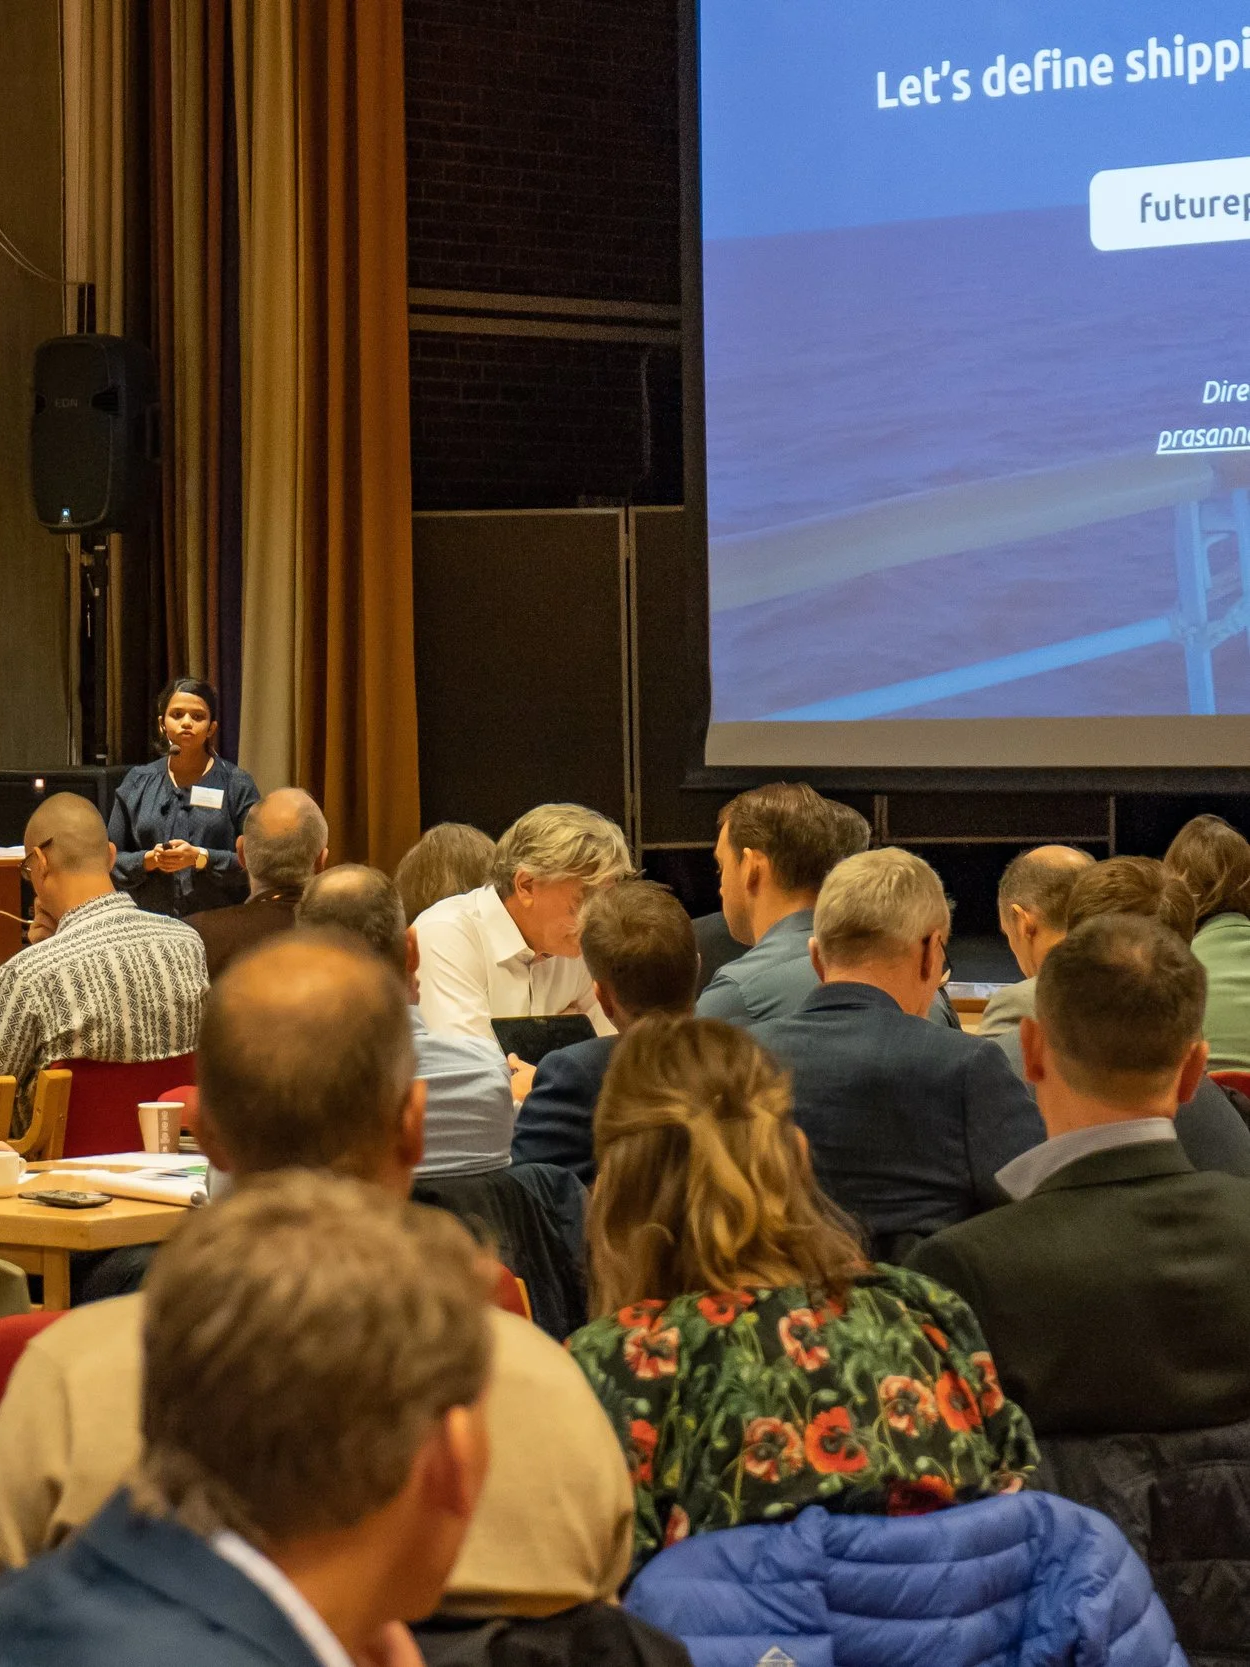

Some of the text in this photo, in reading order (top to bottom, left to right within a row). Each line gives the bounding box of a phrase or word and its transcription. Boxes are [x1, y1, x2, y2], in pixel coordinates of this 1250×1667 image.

[876, 60, 972, 109] Let's
[982, 47, 1115, 98] define
[1155, 426, 1250, 454] prasann
